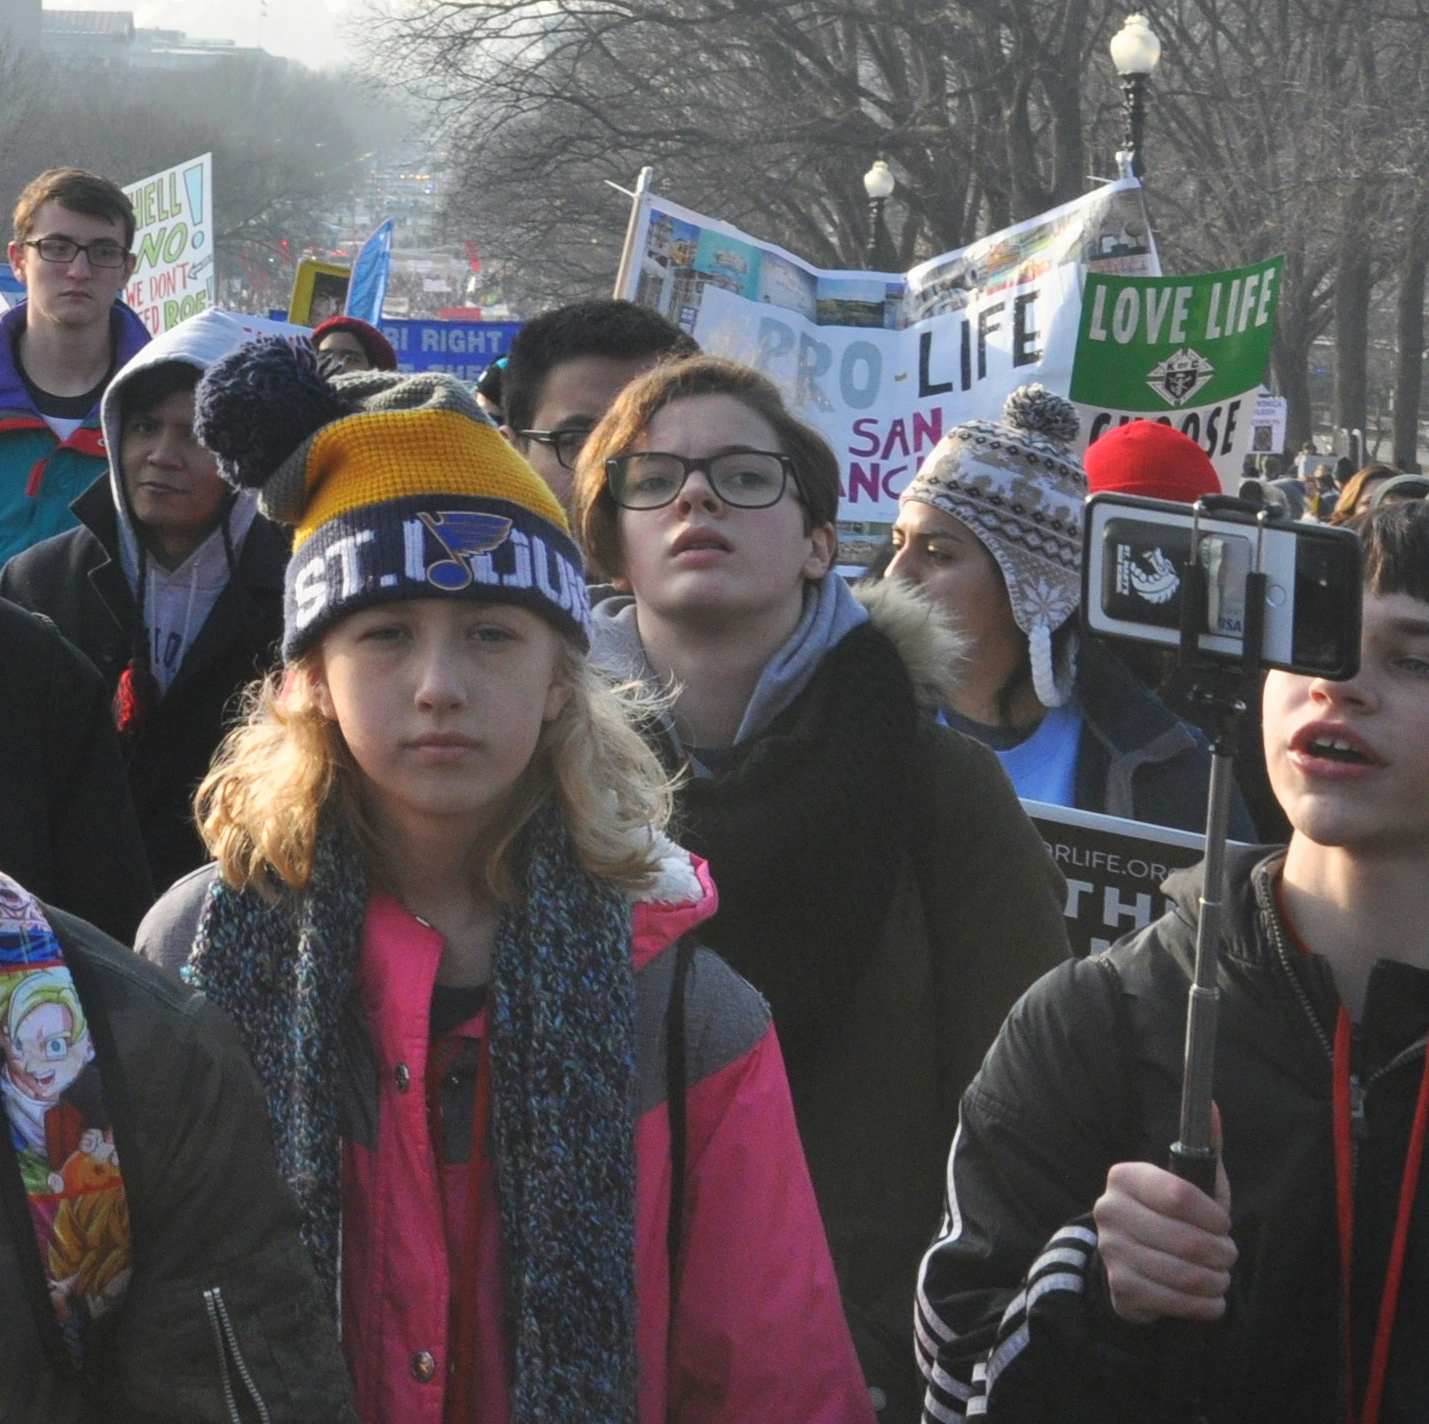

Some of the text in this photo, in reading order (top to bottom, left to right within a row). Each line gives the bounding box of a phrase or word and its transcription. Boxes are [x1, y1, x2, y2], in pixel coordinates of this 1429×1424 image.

[149, 262, 190, 302] DON'T
[1089, 267, 1275, 344] LOVE LIFE
[422, 329, 503, 354] RIGHT
[848, 407, 943, 460] SAN
[1043, 840, 1172, 881] RLIFE.OR
[1063, 878, 1178, 929] TH
